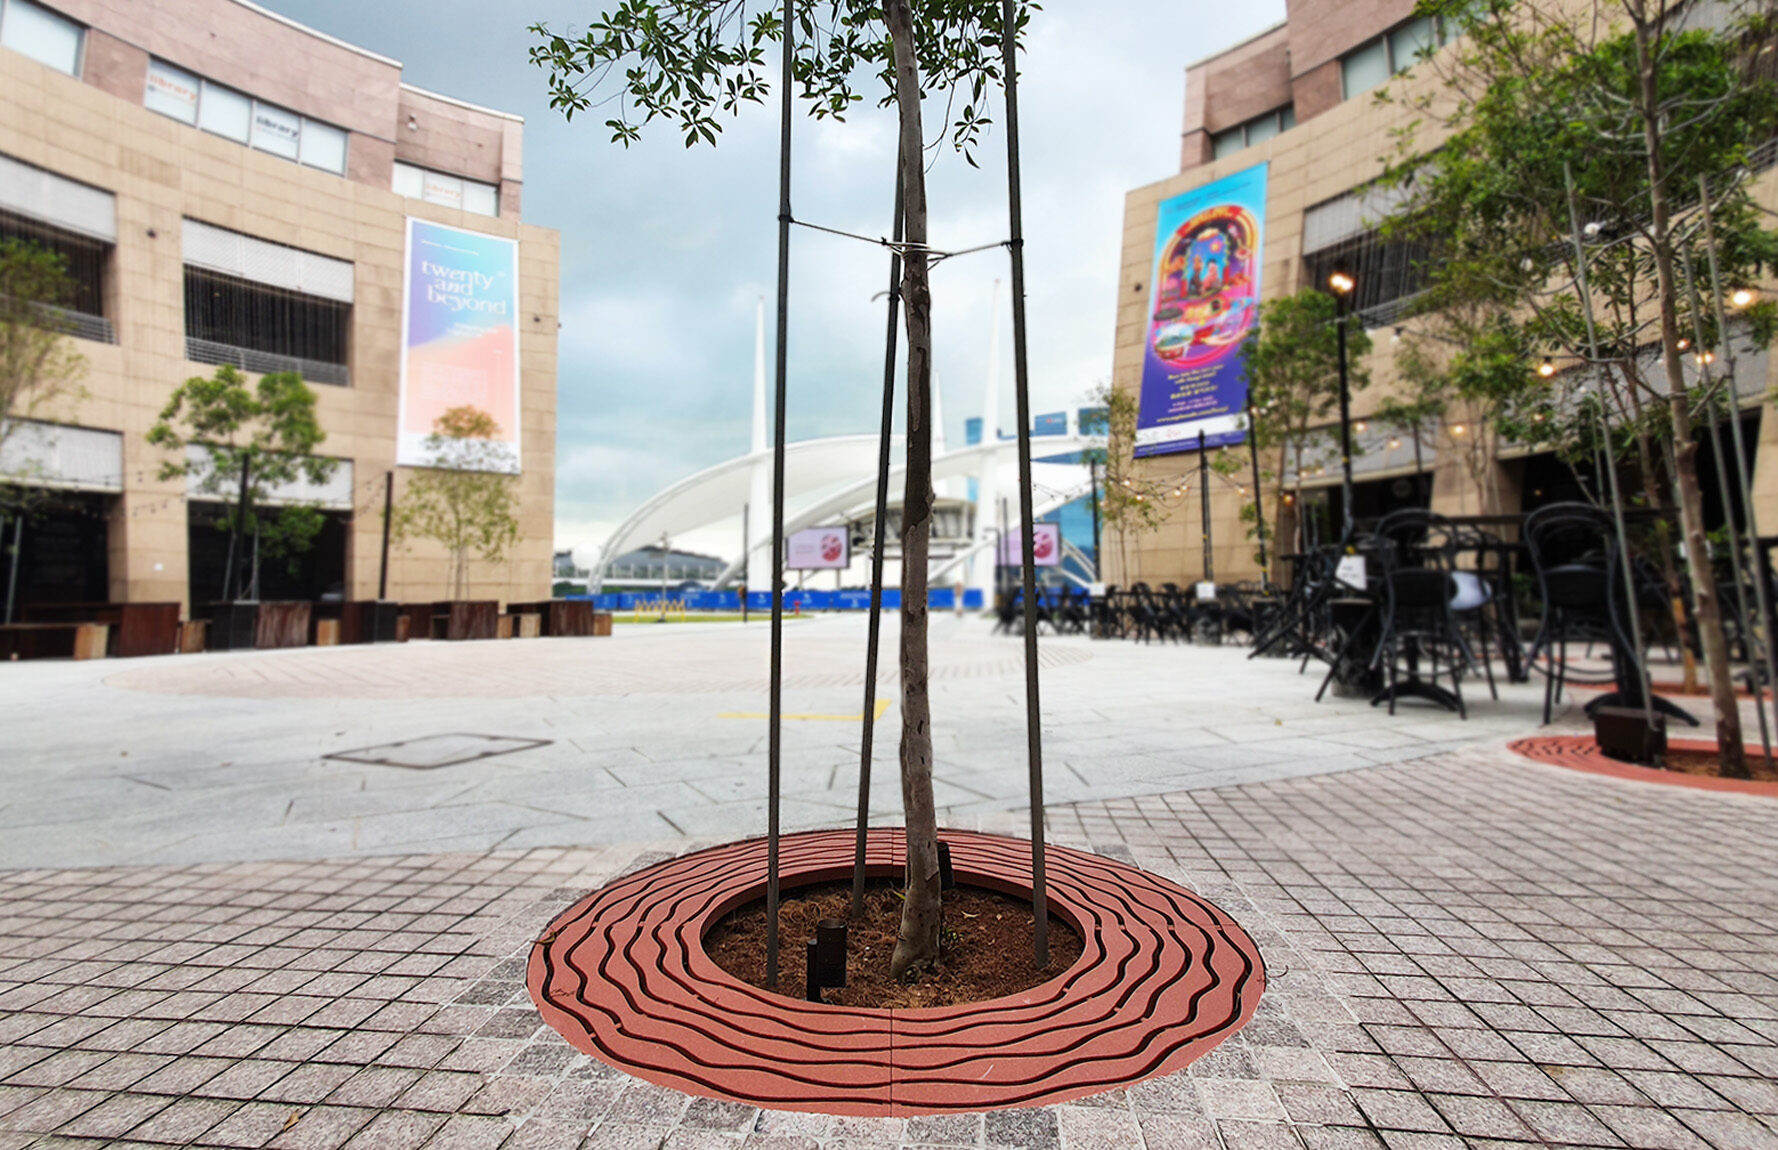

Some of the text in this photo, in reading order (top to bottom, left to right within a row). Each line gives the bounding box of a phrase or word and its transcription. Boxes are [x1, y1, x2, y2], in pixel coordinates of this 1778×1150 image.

[256, 115, 299, 137] library
[421, 261, 494, 291] twenty
[434, 279, 473, 296] and
[427, 284, 506, 314] beyond
